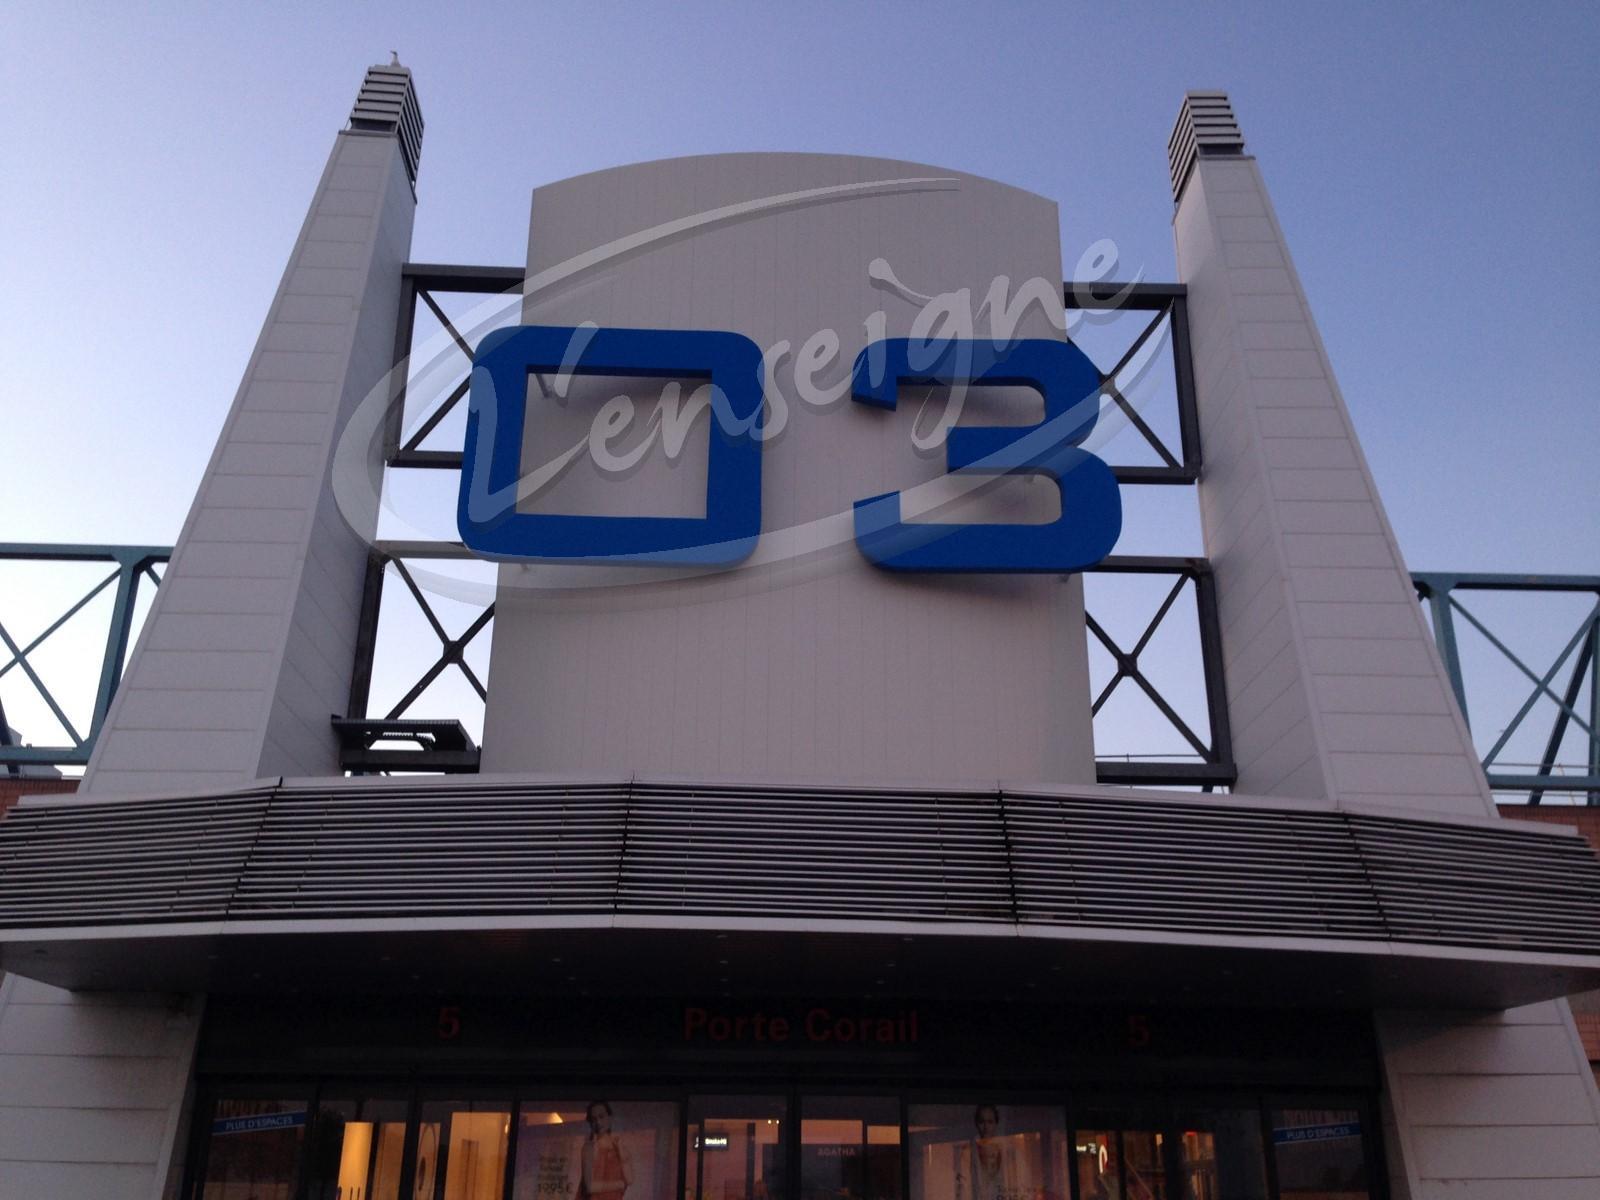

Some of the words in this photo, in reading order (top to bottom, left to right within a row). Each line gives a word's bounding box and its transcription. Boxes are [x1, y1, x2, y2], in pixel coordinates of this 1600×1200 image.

[438, 1007, 460, 1040] 5
[683, 1007, 790, 1041] Porte
[804, 1007, 920, 1043] Corail
[1127, 1015, 1151, 1048] 5
